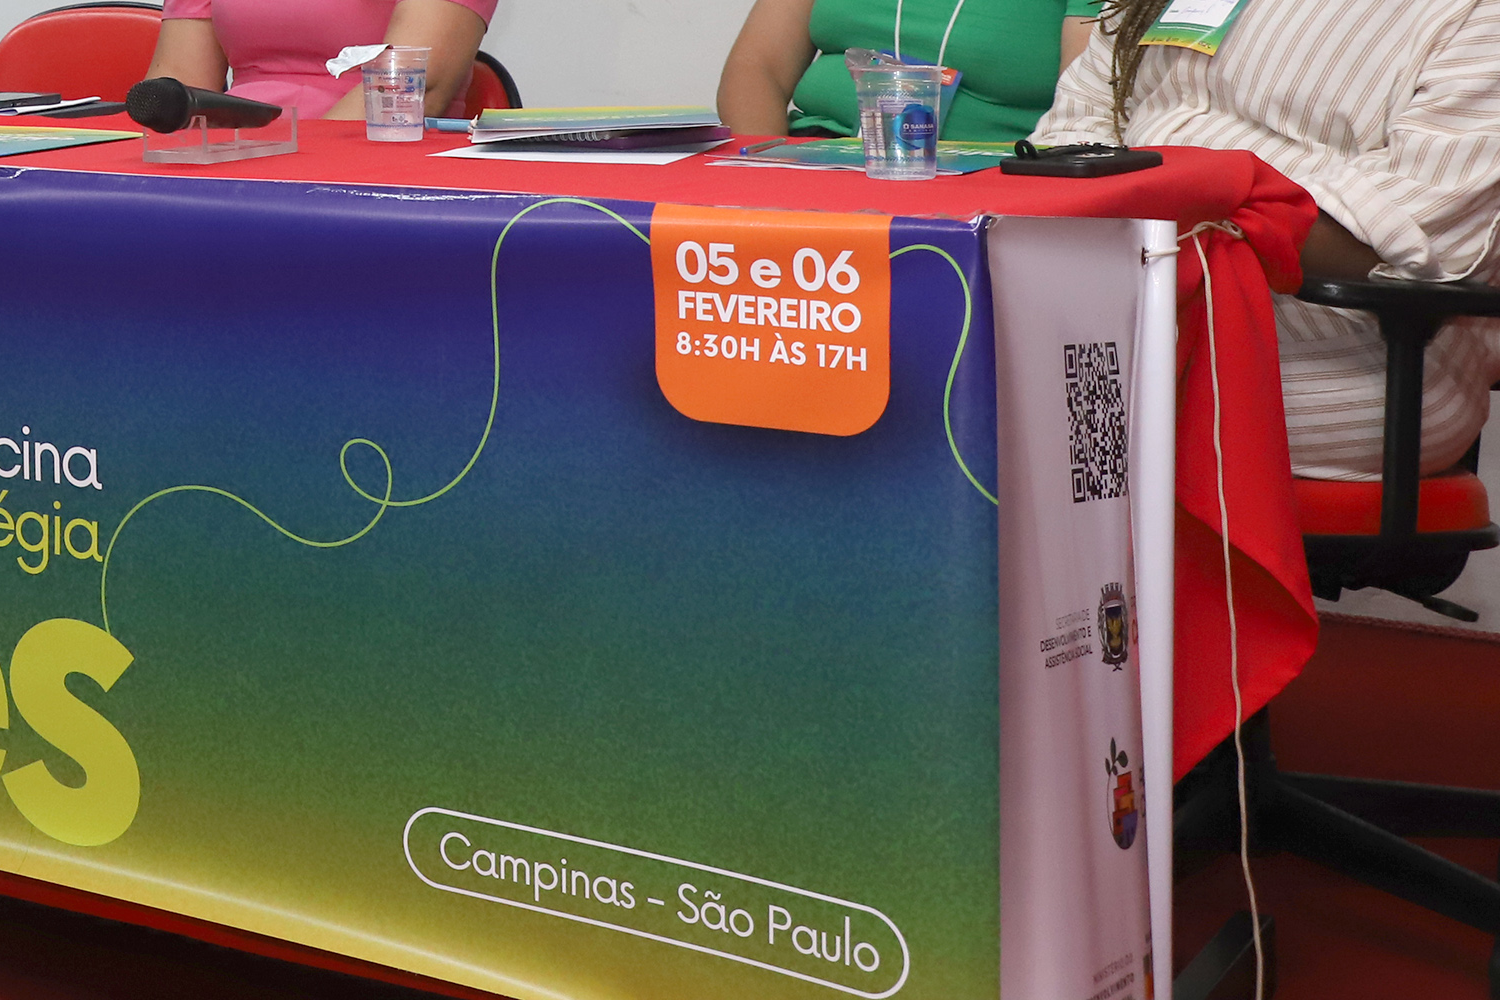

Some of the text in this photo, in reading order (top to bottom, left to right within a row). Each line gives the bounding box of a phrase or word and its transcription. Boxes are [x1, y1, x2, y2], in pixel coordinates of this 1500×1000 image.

[675, 240, 860, 294] 05 e 06
[677, 290, 862, 334] FEVEREIRO
[675, 331, 867, 372] 8:30H ÀS 17H
[439, 831, 636, 910] Campinas
[676, 883, 755, 938] São
[768, 903, 881, 973] Paulo
